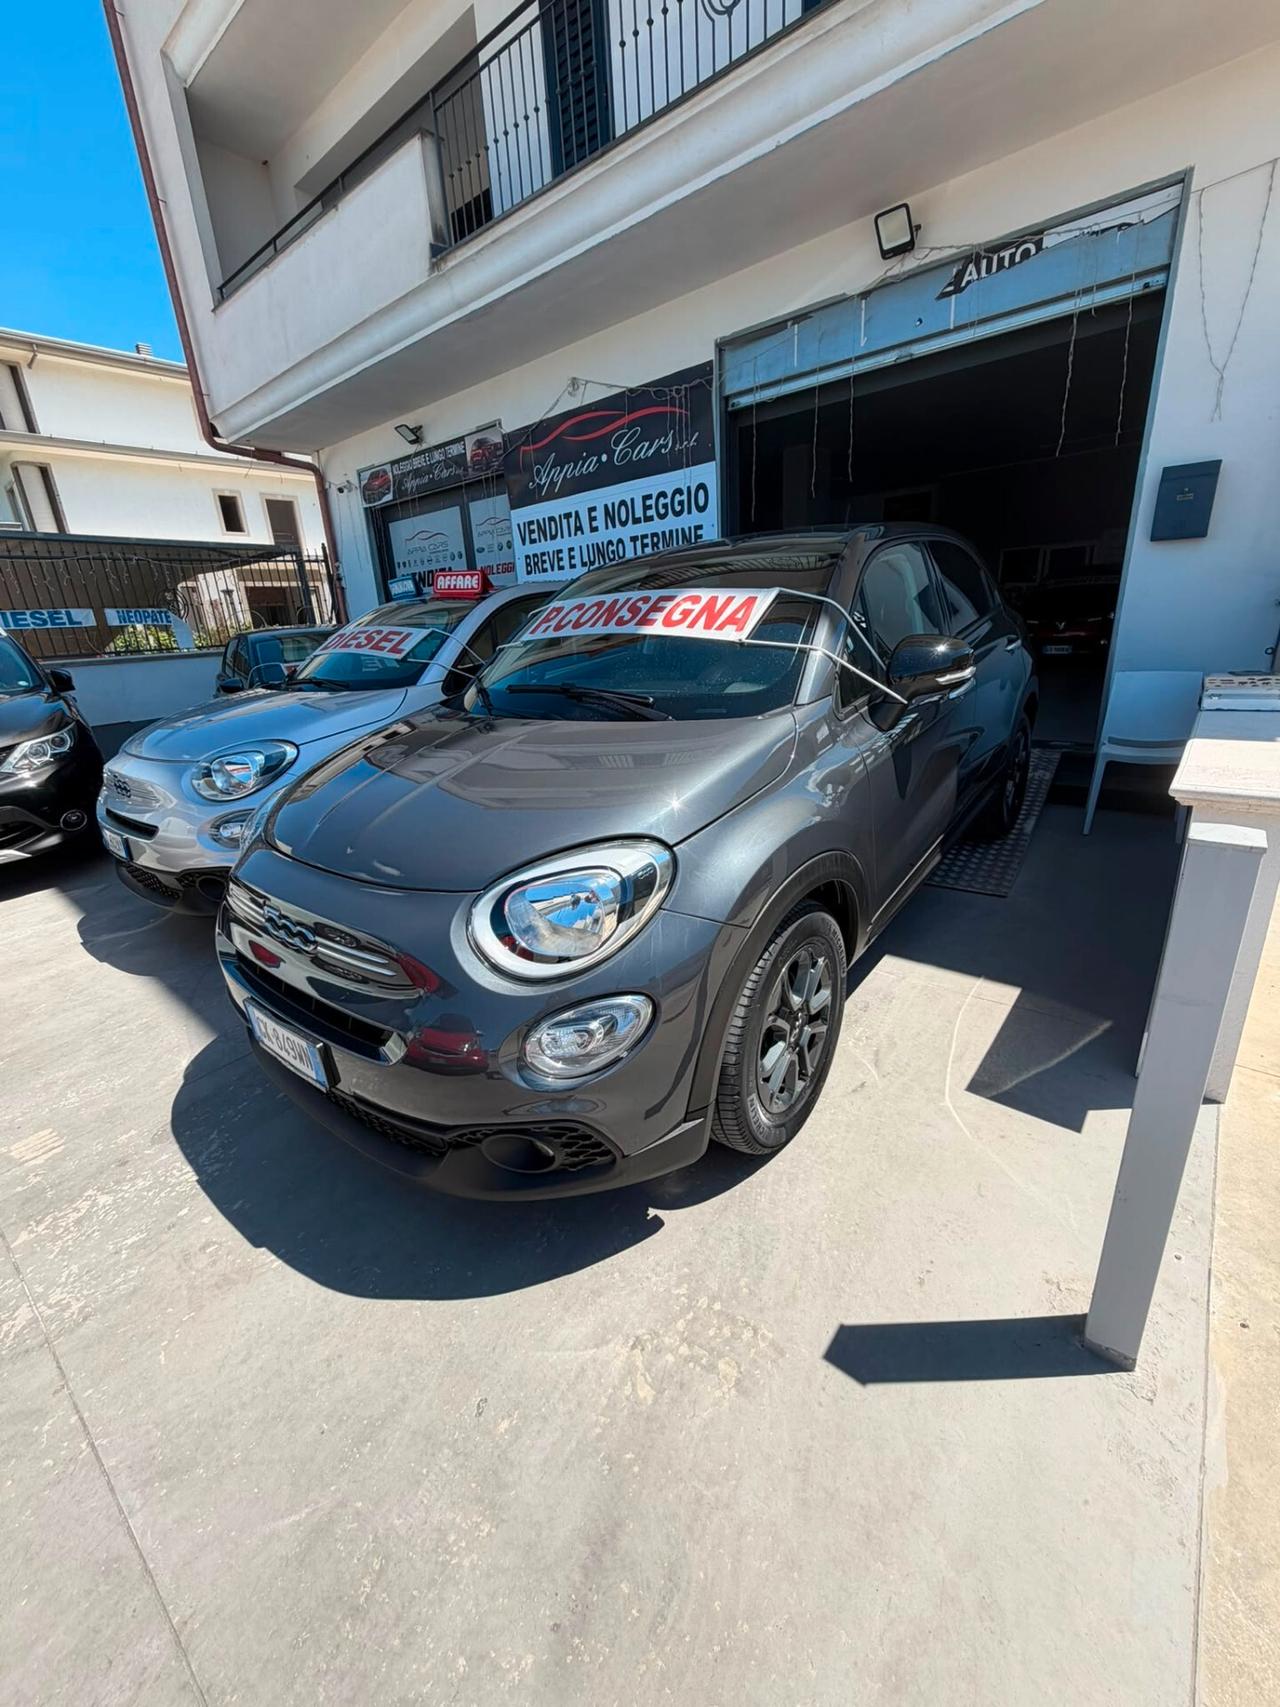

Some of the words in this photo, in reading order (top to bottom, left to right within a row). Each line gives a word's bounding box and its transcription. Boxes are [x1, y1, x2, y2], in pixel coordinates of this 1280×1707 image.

[960, 242, 1037, 287] AUTO
[529, 452, 600, 496] Appia
[611, 426, 674, 466] Cars
[517, 510, 584, 547] VENDITA
[587, 506, 599, 533] E
[604, 482, 709, 530] NOLEGGIO
[525, 548, 565, 575] BREVE
[568, 546, 577, 570] E
[579, 537, 626, 567] LUNGO
[629, 524, 703, 555] TERMINE
[437, 575, 478, 589] AFFARE
[529, 594, 759, 634] P.CONSEGNA
[320, 629, 413, 654] DIESEL
